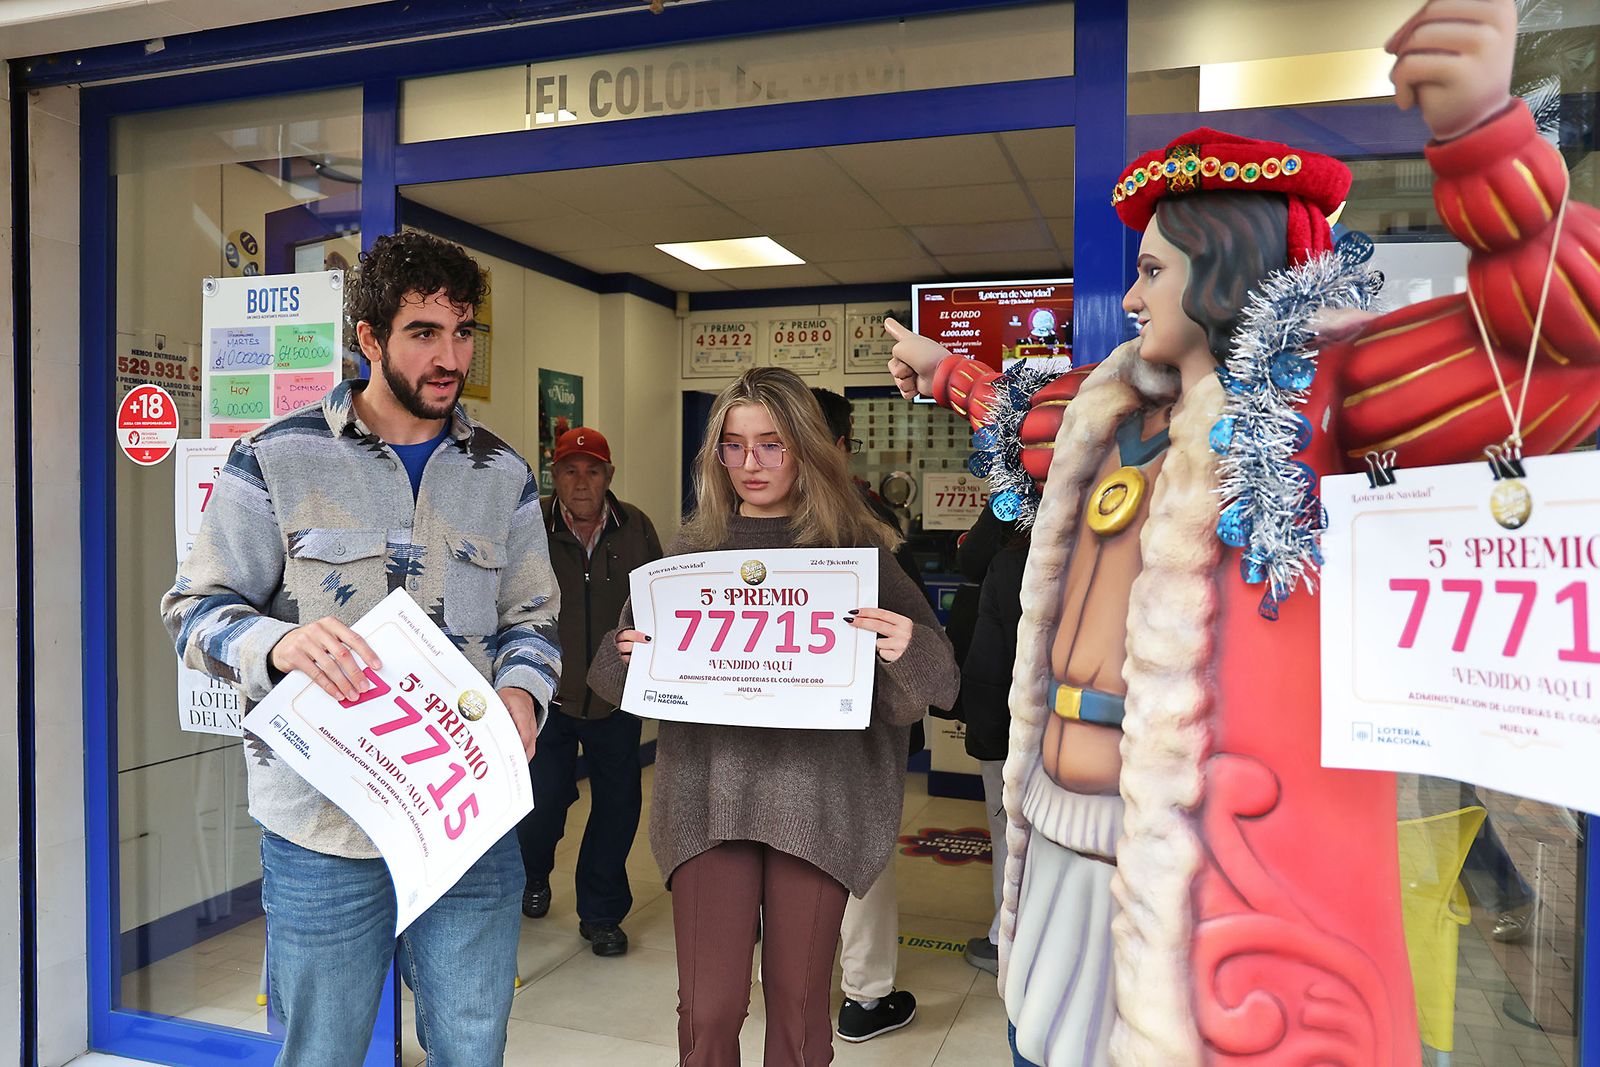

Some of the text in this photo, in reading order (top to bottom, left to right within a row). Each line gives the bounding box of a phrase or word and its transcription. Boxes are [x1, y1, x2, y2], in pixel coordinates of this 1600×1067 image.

[536, 74, 577, 124] EL
[247, 286, 300, 314] BOTES
[940, 310, 981, 319] EL GORDO
[711, 324, 745, 332] PREMIO
[791, 320, 826, 329] PREMIO
[228, 338, 260, 347] MARTES
[298, 335, 314, 343] HOY
[696, 333, 751, 346] 43422
[775, 330, 831, 343] 08080
[131, 349, 187, 362] HEMOS ENTREGADO
[118, 356, 199, 381] 529.931 €
[163, 381, 182, 389] LARGO
[230, 386, 250, 395] HOY
[290, 384, 327, 392] DOMINGO
[129, 393, 164, 419] +18
[577, 436, 584, 445] C
[935, 492, 988, 507] 77715
[724, 588, 809, 606] PREMIO
[1389, 578, 1600, 664] 7771
[674, 610, 836, 654] 77715
[709, 658, 793, 673] VENDIDO AQUÍ
[778, 676, 800, 684] COLÓN
[1452, 667, 1592, 702] VENDIDO AQUÍ
[191, 690, 240, 710] LOTE
[189, 709, 222, 727] DEL
[1489, 702, 1500, 710] DE
[1555, 712, 1565, 720] EL
[424, 693, 488, 780] PREMIO
[1377, 726, 1421, 737] LOTERÍA
[1499, 723, 1539, 737] HUELVA
[282, 731, 310, 760] NACIONAL
[286, 727, 310, 750] LOTERÍA
[1377, 736, 1432, 747] NACIONAL
[338, 666, 479, 840] 77715
[357, 736, 432, 816] VENDIDO AQUÍ
[366, 781, 390, 805] HUELVA
[369, 768, 379, 778] DE
[401, 802, 408, 812] EL
[908, 937, 966, 953] DISTAN
